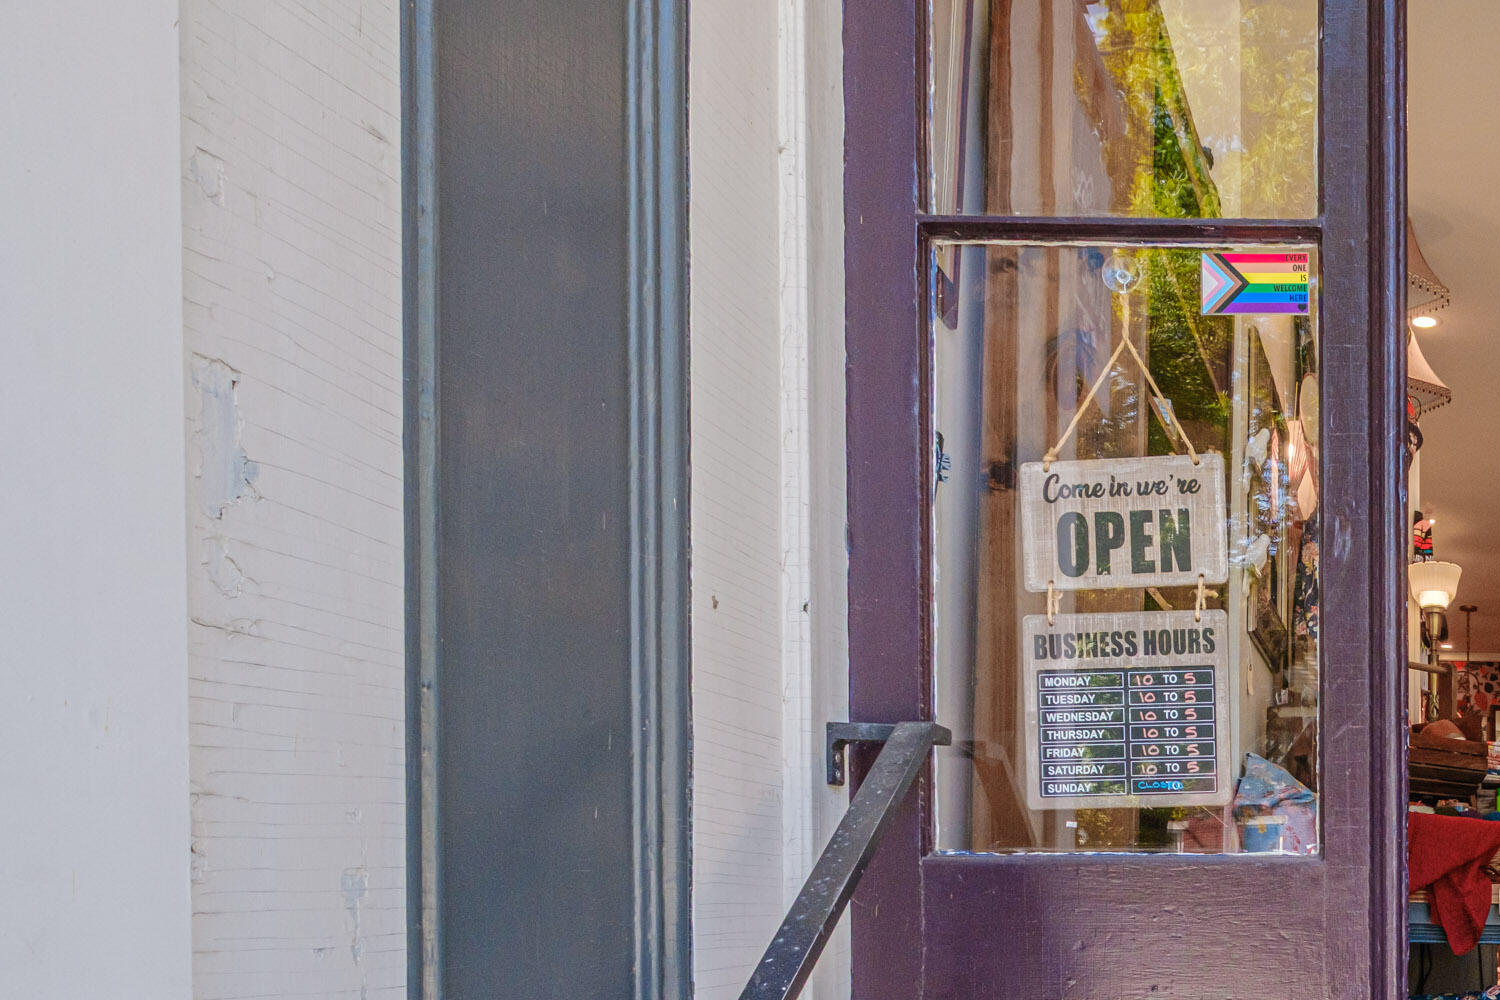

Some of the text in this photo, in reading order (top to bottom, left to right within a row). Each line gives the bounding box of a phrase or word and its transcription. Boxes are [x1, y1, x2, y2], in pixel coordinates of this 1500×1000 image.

[1285, 254, 1307, 262] EVERY
[1292, 264, 1307, 272] ONE
[1300, 274, 1307, 282] IS
[1273, 284, 1307, 292] WELCOME
[1289, 294, 1307, 302] HERE
[1043, 473, 1201, 504] Come in we're
[1057, 508, 1192, 578] OPEN
[1034, 627, 1216, 660] BUSINESS HOURS
[1045, 672, 1196, 687] MONDAY 10 TO 5
[1046, 690, 1197, 705] TUESDAY 10 TO 5
[1046, 708, 1197, 722] WEDNESDAY 10 TO 5
[1047, 726, 1197, 740] THURSDAY 10 TO 5
[1046, 744, 1200, 758] FRIDAY 10 TO 5
[1048, 761, 1200, 775] SATURDAY 10 TO 5
[1047, 782, 1093, 793] SUNDAY
